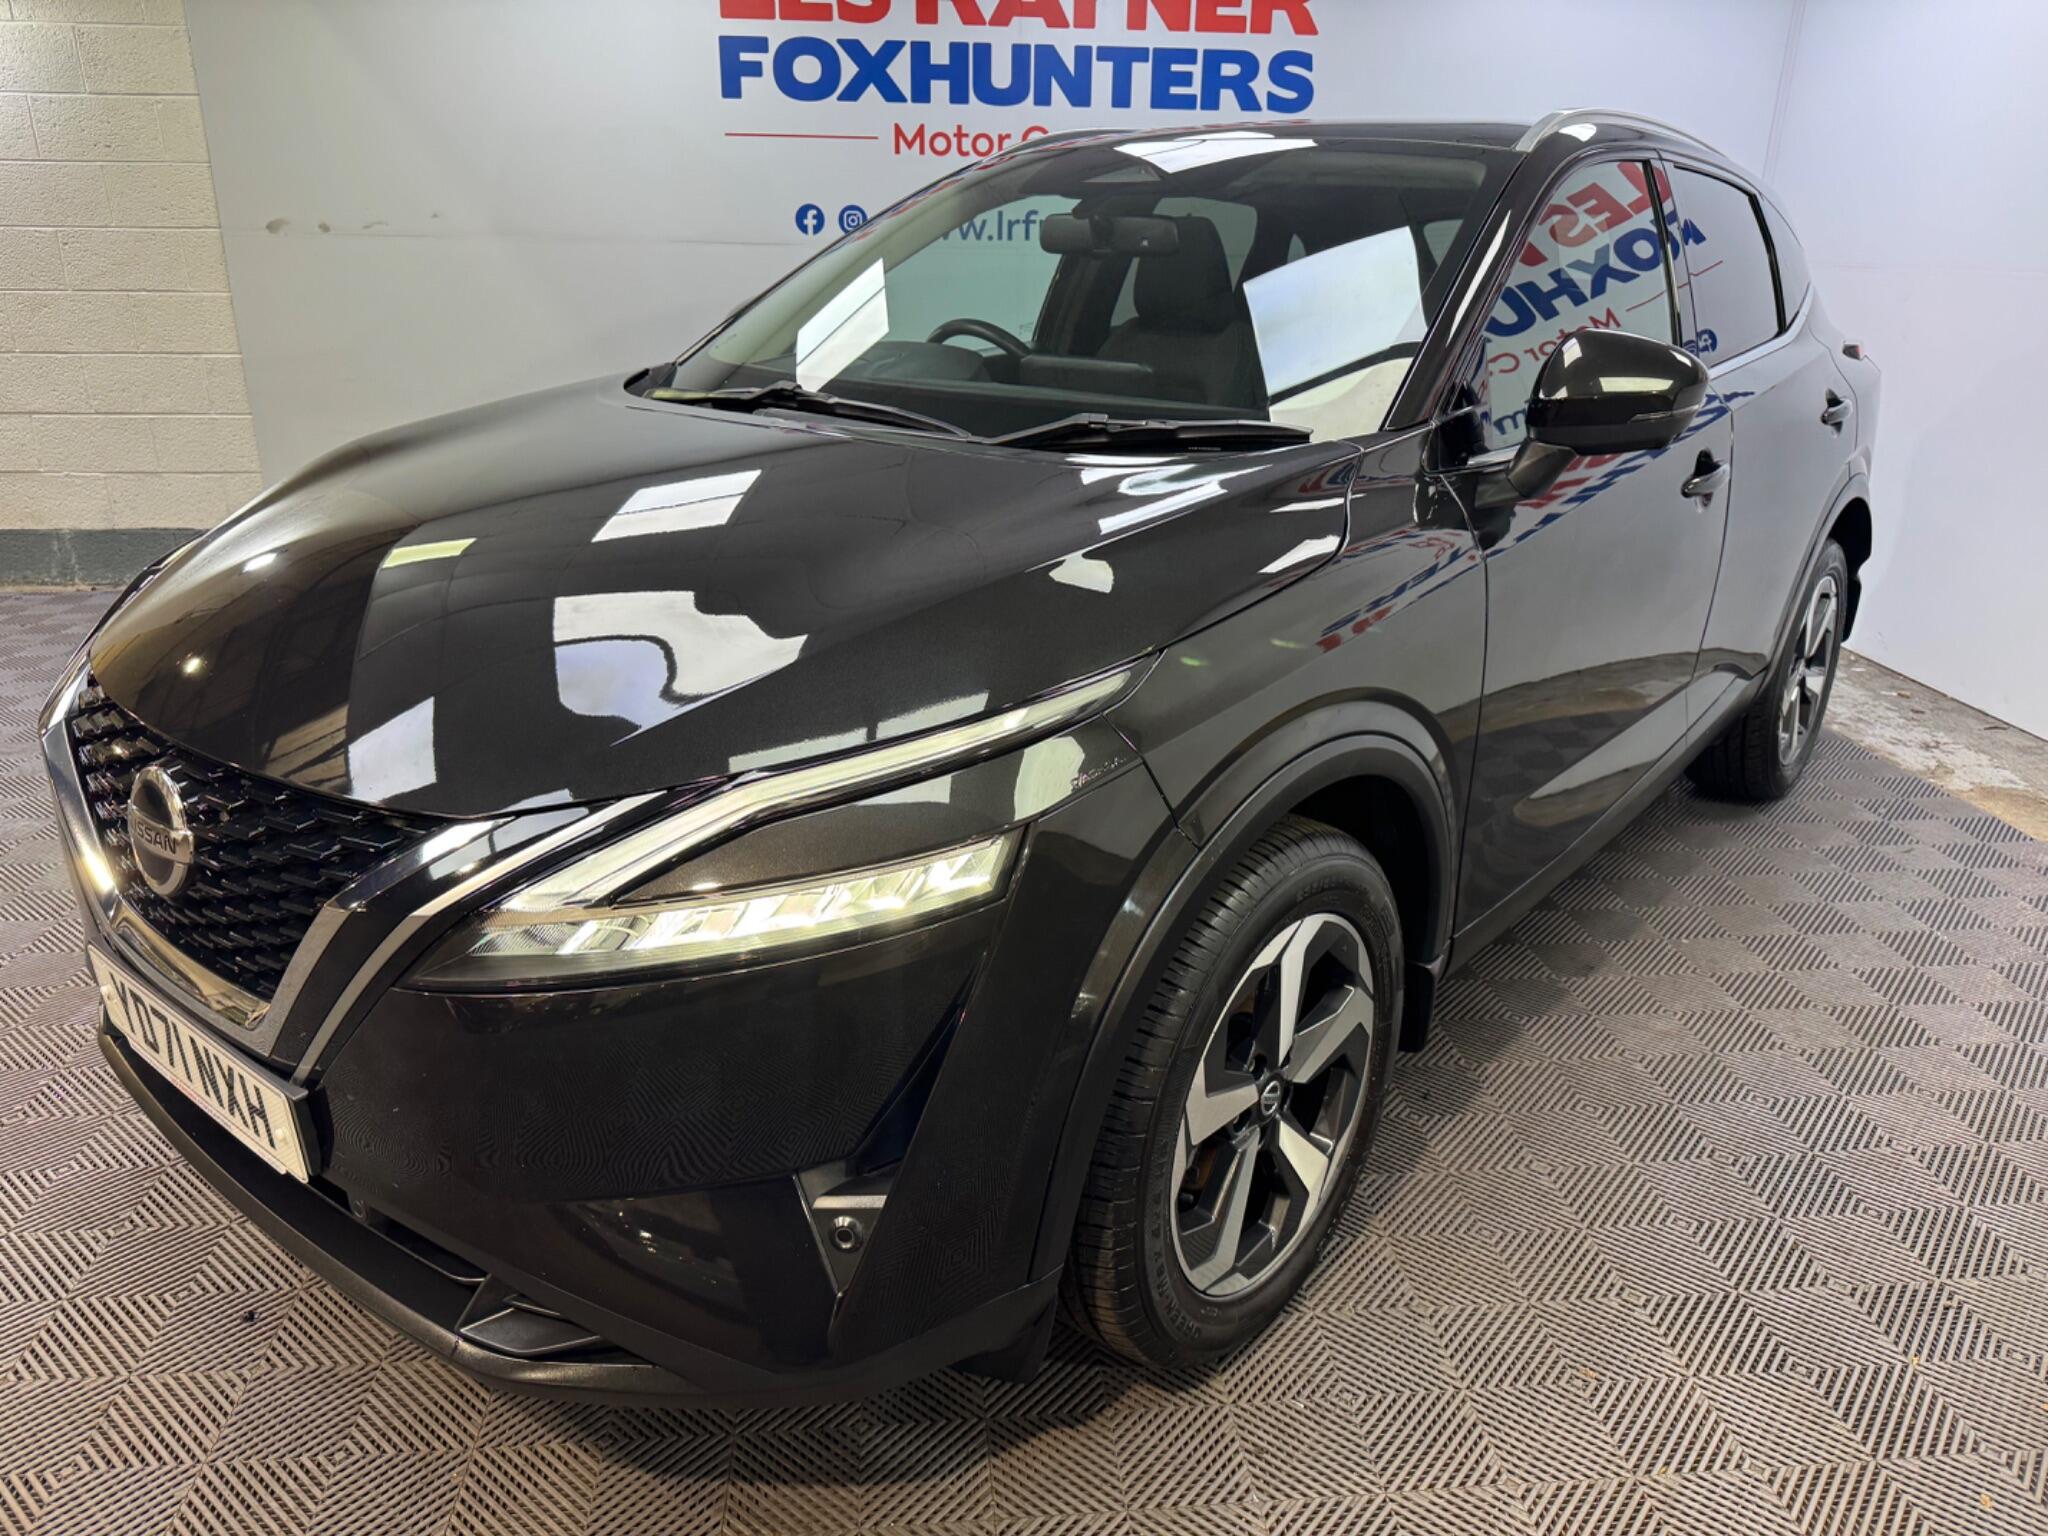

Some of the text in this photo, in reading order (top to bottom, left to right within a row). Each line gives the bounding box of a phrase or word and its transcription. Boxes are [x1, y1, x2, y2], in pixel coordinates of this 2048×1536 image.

[718, 35, 1315, 114] FOXHUNTERS
[894, 122, 1012, 157] Motor
[131, 815, 177, 856] ISSAN
[109, 969, 194, 1083] YD71
[188, 1034, 276, 1150] NXH
